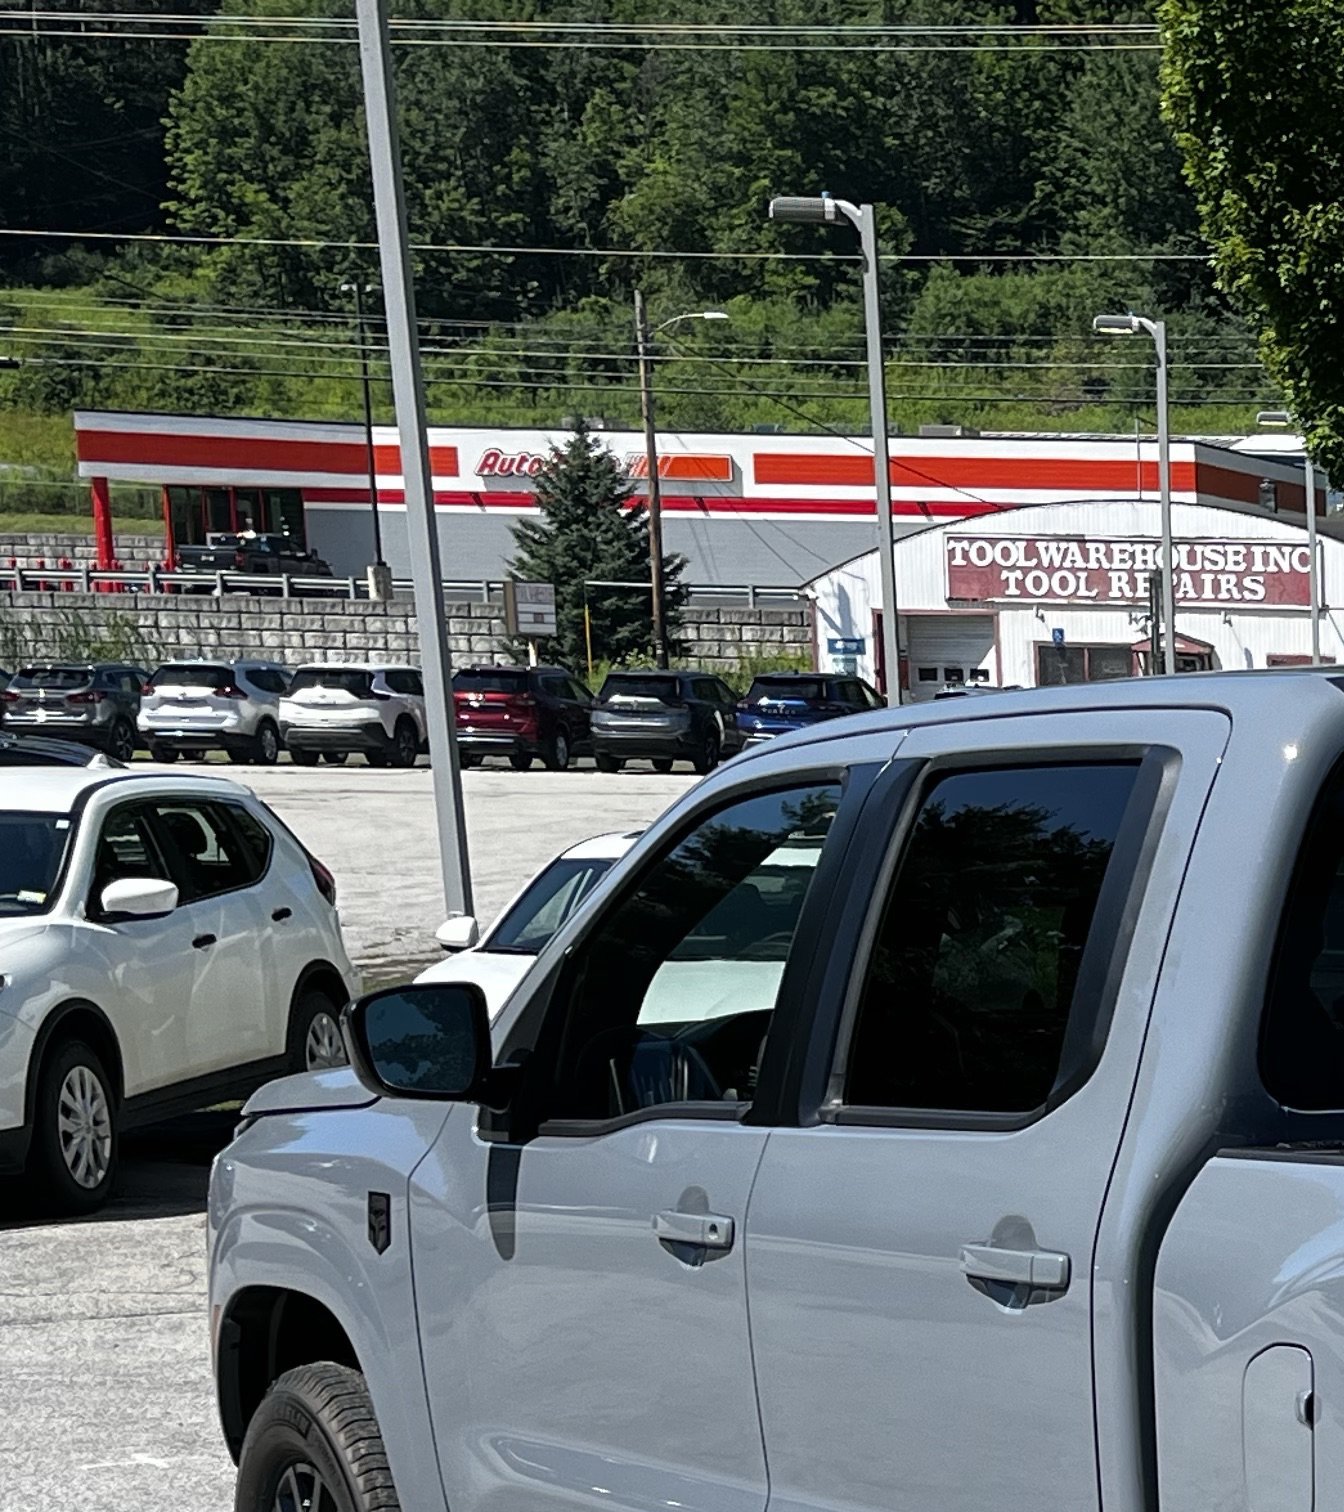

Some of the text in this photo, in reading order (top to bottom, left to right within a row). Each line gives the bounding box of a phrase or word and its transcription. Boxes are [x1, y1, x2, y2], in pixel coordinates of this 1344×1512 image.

[948, 540, 1036, 567] TOOL
[1035, 542, 1252, 572] WAREHOUSE
[1000, 570, 1265, 600] TOOL REAIRS
